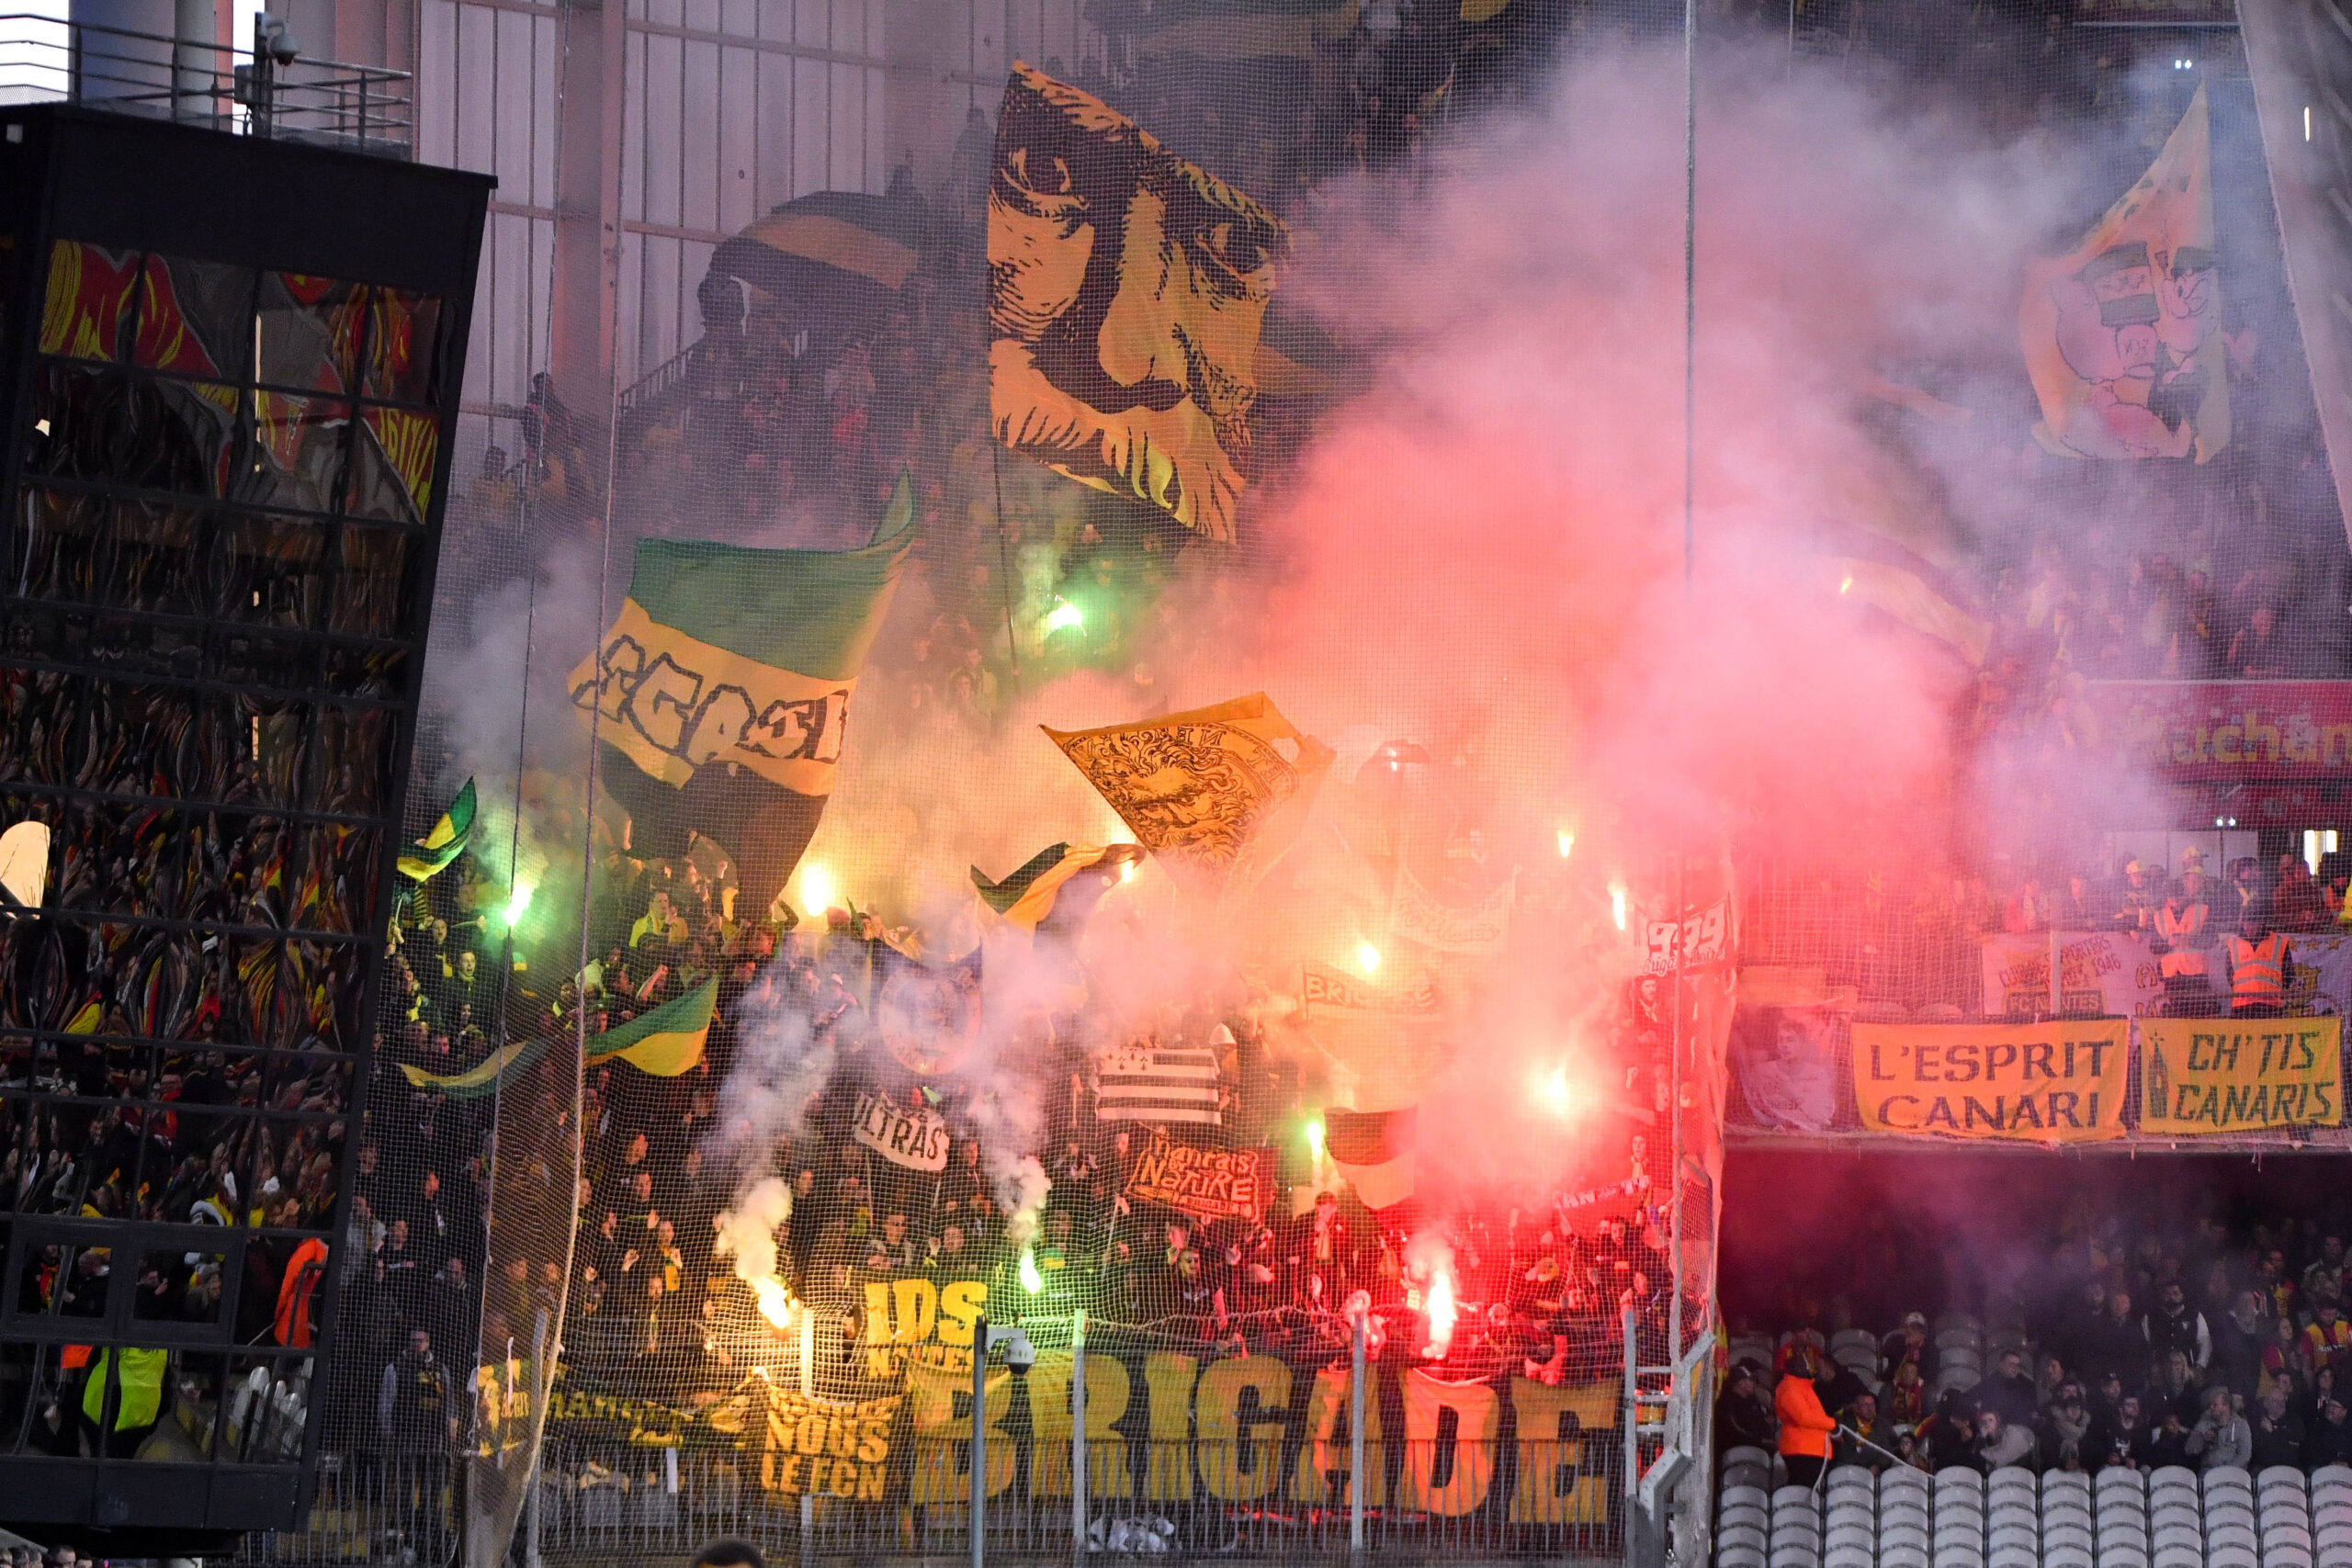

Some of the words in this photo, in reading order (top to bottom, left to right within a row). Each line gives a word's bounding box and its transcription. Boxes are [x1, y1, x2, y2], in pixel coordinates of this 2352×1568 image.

[2132, 709, 2352, 765] uchan
[2035, 994, 2099, 1011] NNTES
[1870, 1040, 2114, 1083] L'ESPRIT
[1878, 1090, 2099, 1131] CANARI
[2174, 1081, 2335, 1128] CANARIS
[764, 1410, 890, 1463] NOUS
[911, 1351, 1621, 1525] BRIGADE
[762, 1452, 801, 1494] LE
[809, 1457, 888, 1502] FCN
